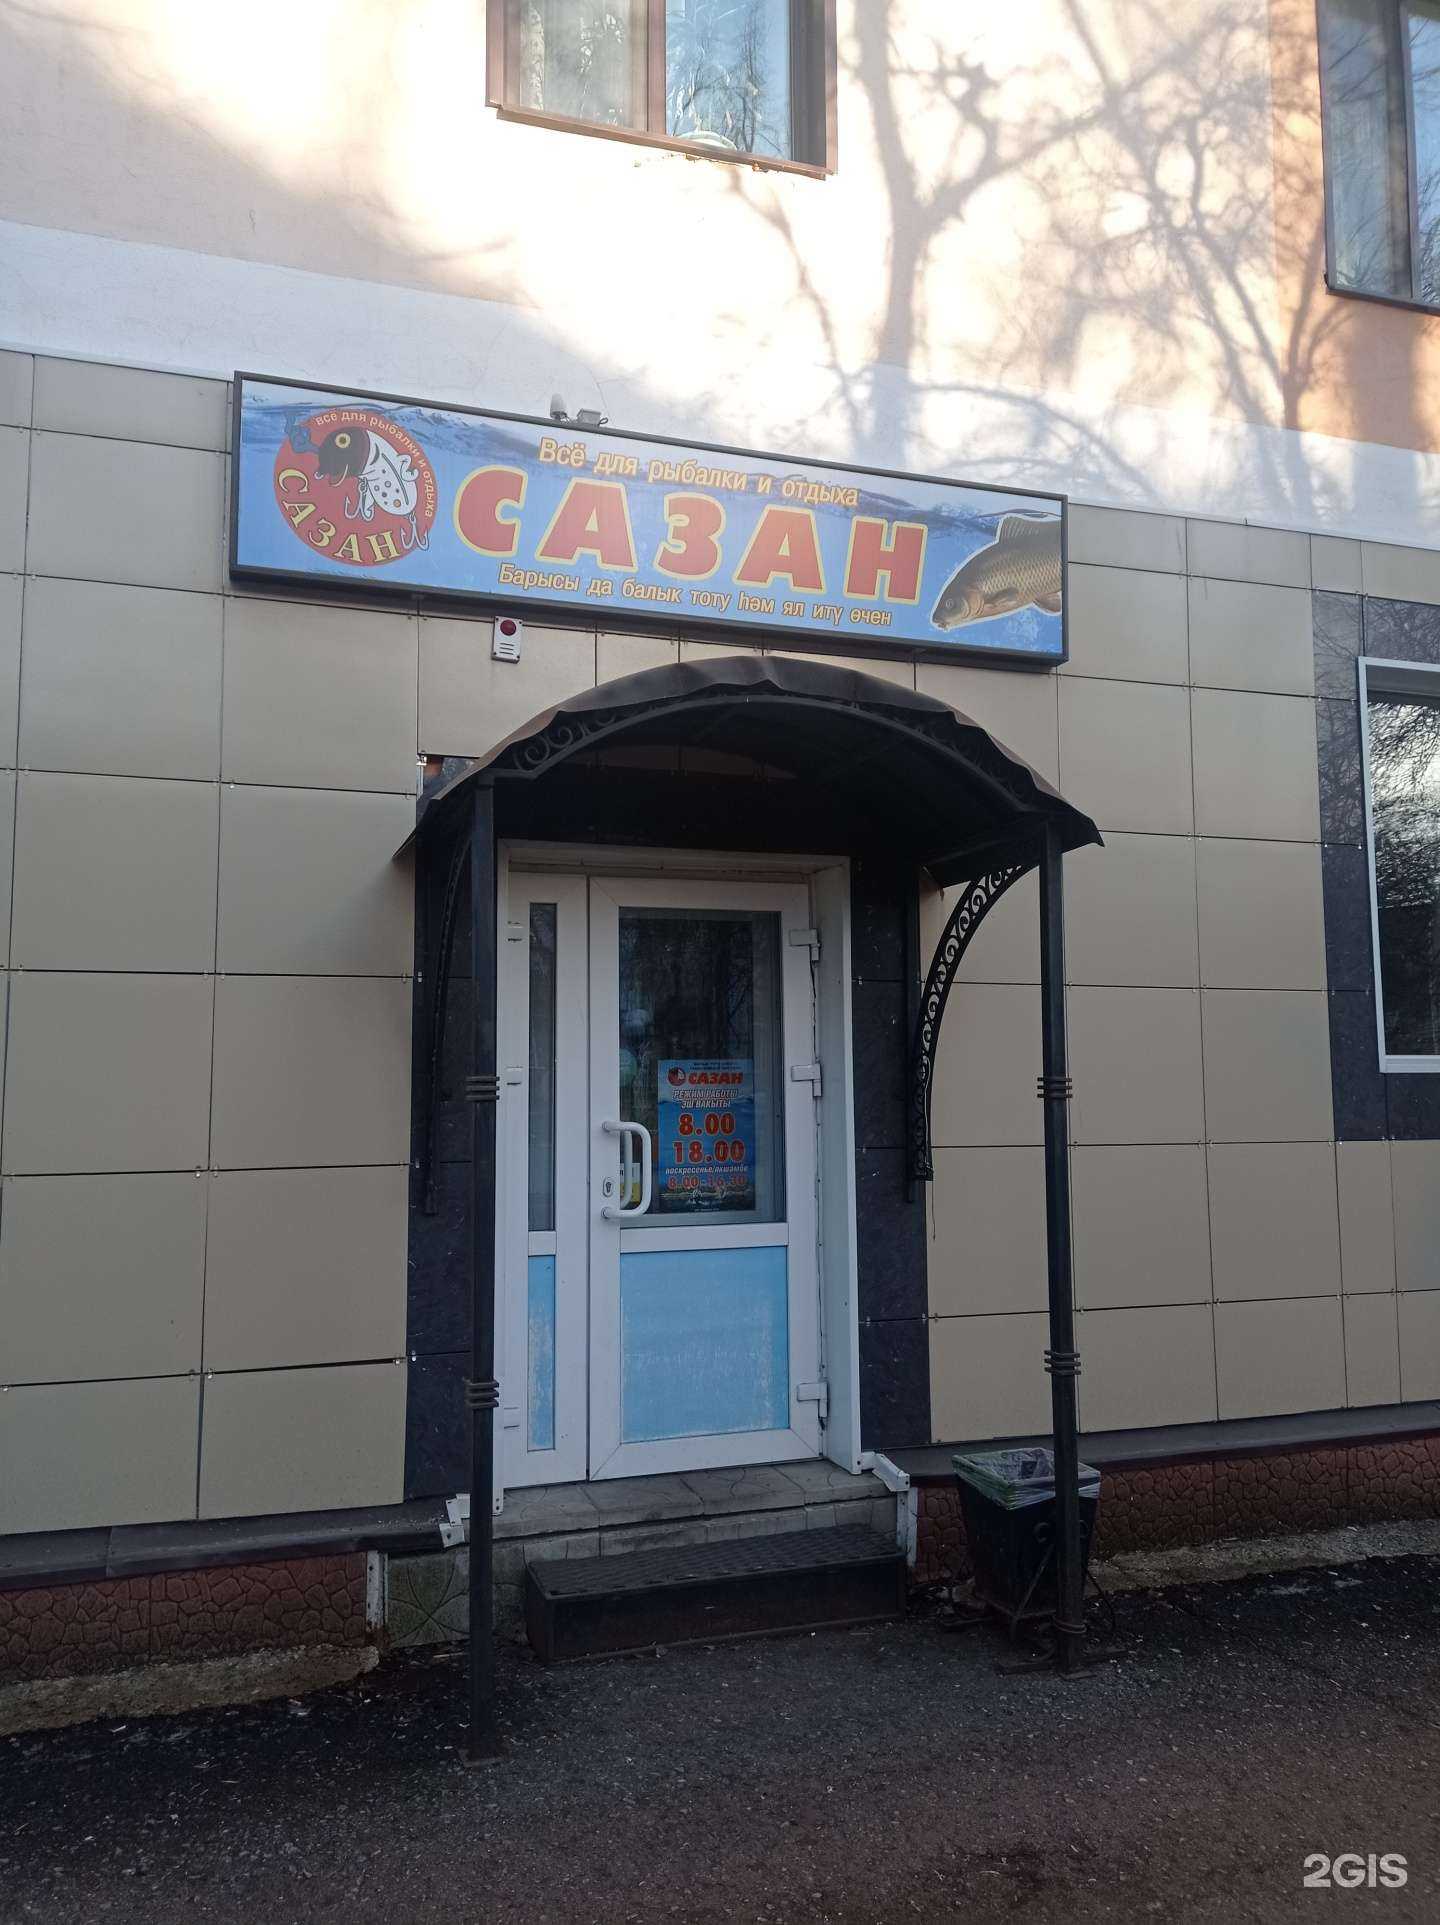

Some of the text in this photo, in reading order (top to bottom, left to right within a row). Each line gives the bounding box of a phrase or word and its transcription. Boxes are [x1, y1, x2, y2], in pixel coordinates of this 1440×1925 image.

[341, 411, 367, 422] для
[369, 417, 420, 457] рыбалки
[418, 458, 427, 468] и
[539, 437, 860, 507] Всё для рыбалки и отдыха
[422, 470, 435, 518] отдыха
[278, 468, 400, 563] САЗАН
[453, 464, 929, 605] САЗАН
[498, 563, 580, 592] Барысы
[586, 579, 614, 596] да
[621, 577, 683, 604] балык
[691, 591, 731, 613] тоту
[782, 601, 805, 618] ял
[849, 609, 894, 626] өчен
[688, 1071, 743, 1085] САЗАН
[673, 1089, 738, 1099] РЕЖИМ РАБОТЫ
[682, 1100, 694, 1109] ЭШ
[679, 1113, 736, 1136] 8.00
[673, 1140, 746, 1164] 18.00
